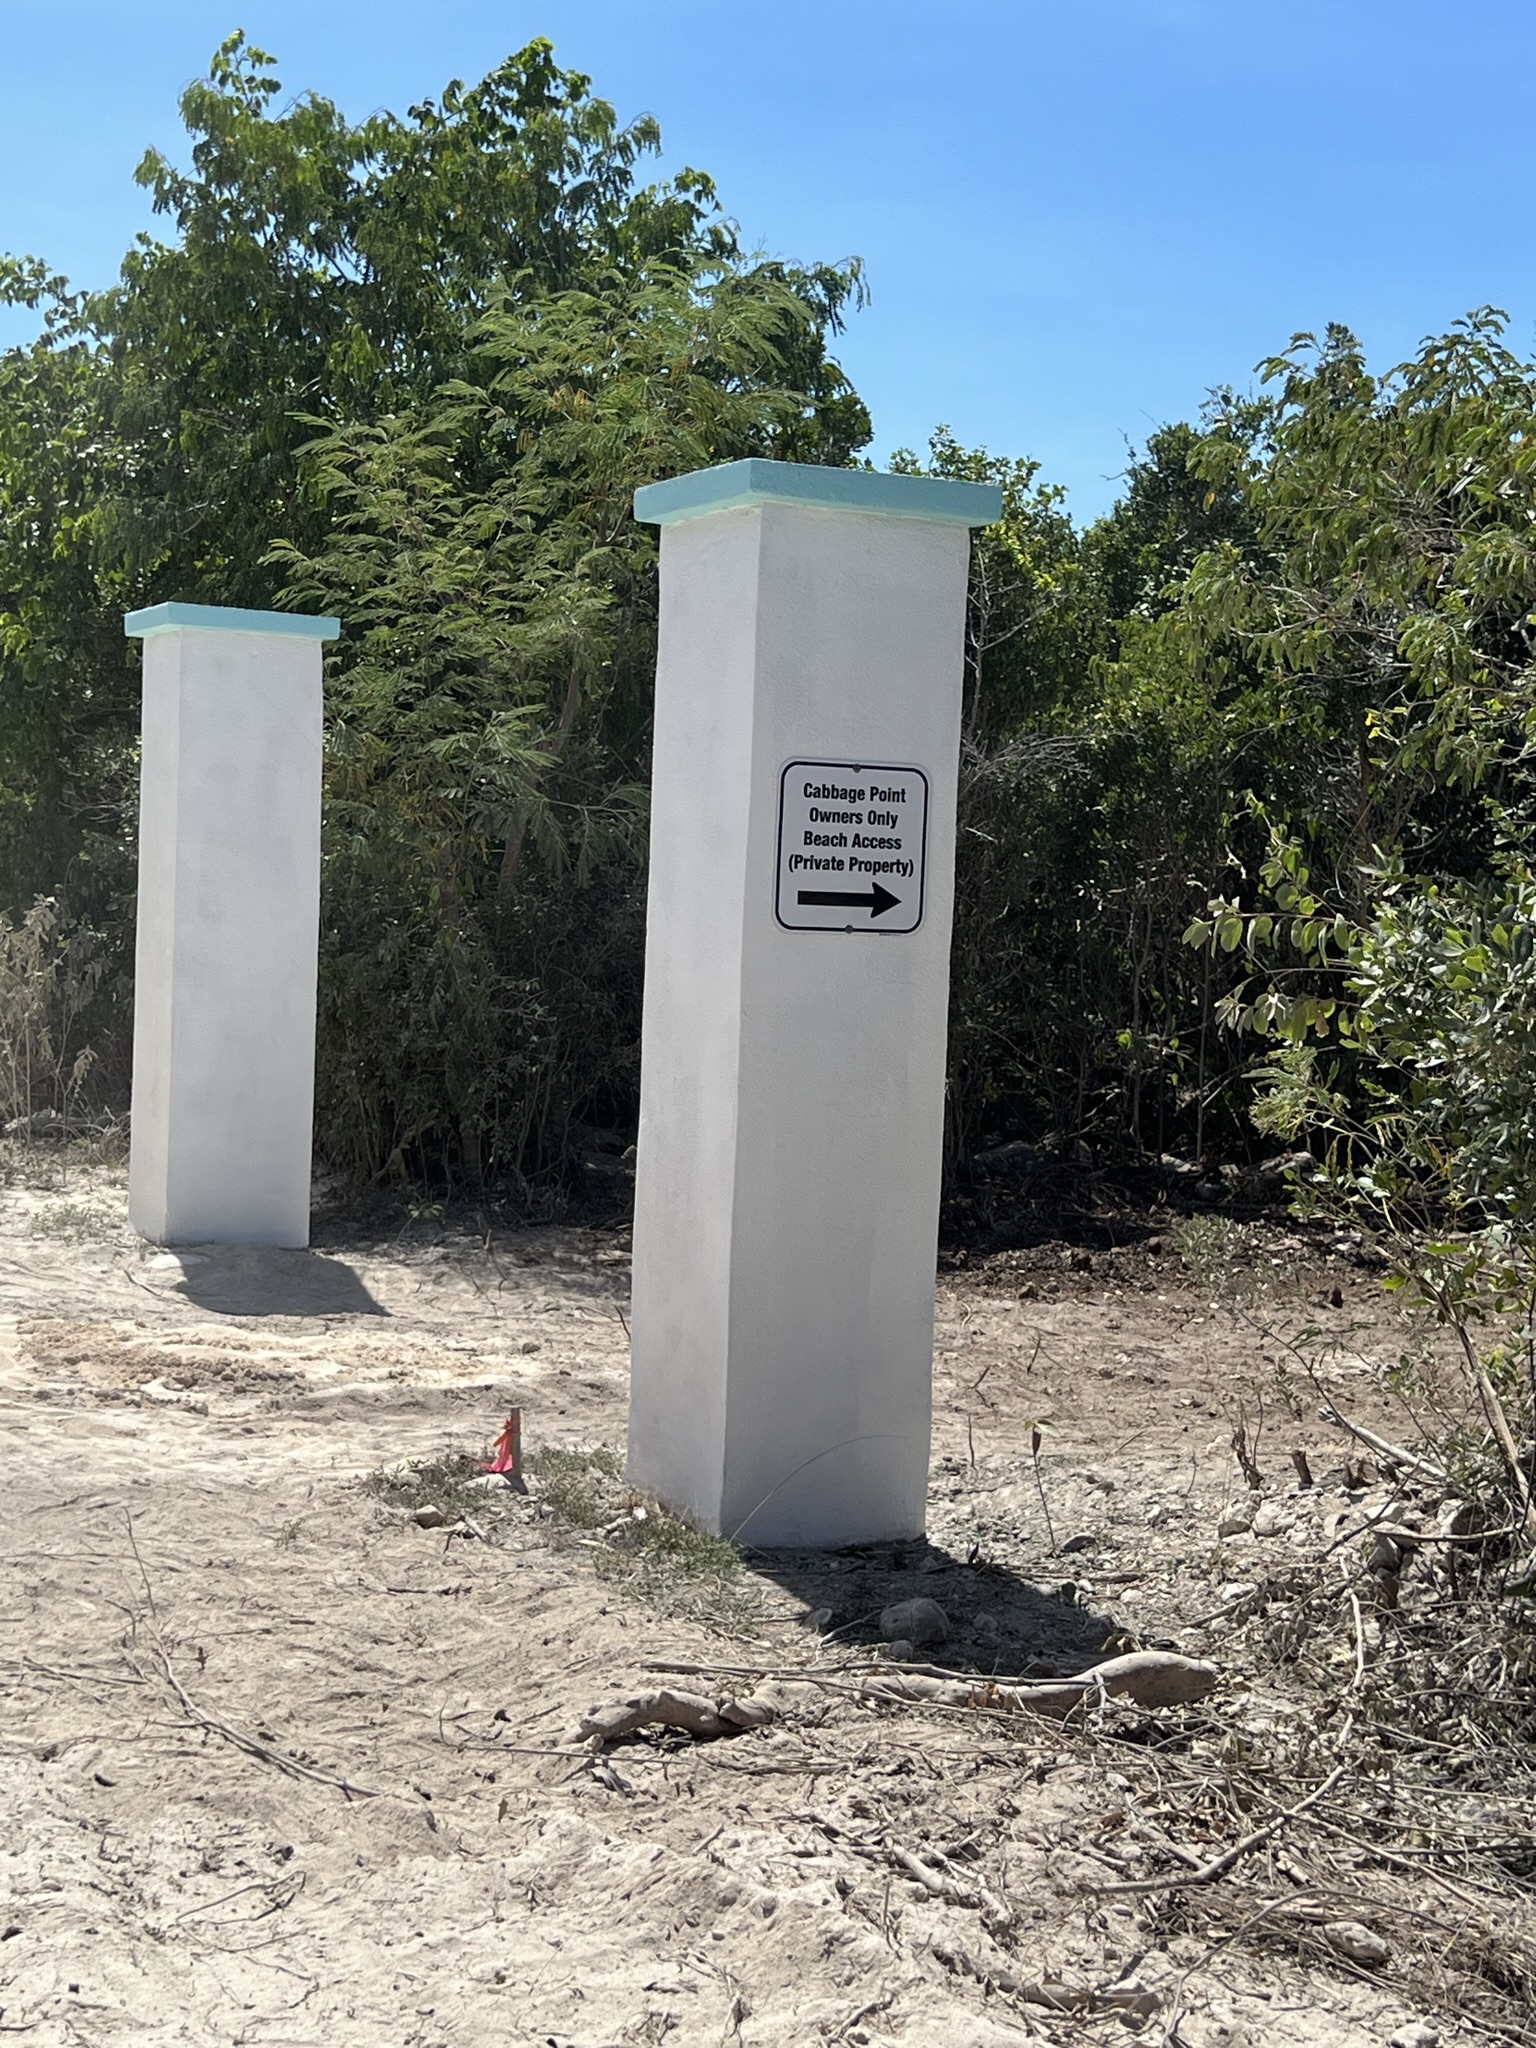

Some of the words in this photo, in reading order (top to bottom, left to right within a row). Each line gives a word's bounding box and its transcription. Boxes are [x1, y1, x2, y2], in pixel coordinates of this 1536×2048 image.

[803, 782, 865, 803] Cabbage
[869, 786, 906, 803] Point
[809, 807, 863, 824] Owners
[867, 810, 899, 829] Only
[803, 830, 848, 848] Beach
[851, 833, 902, 850] Access
[788, 854, 845, 872] (Private
[849, 856, 914, 877] Property)
